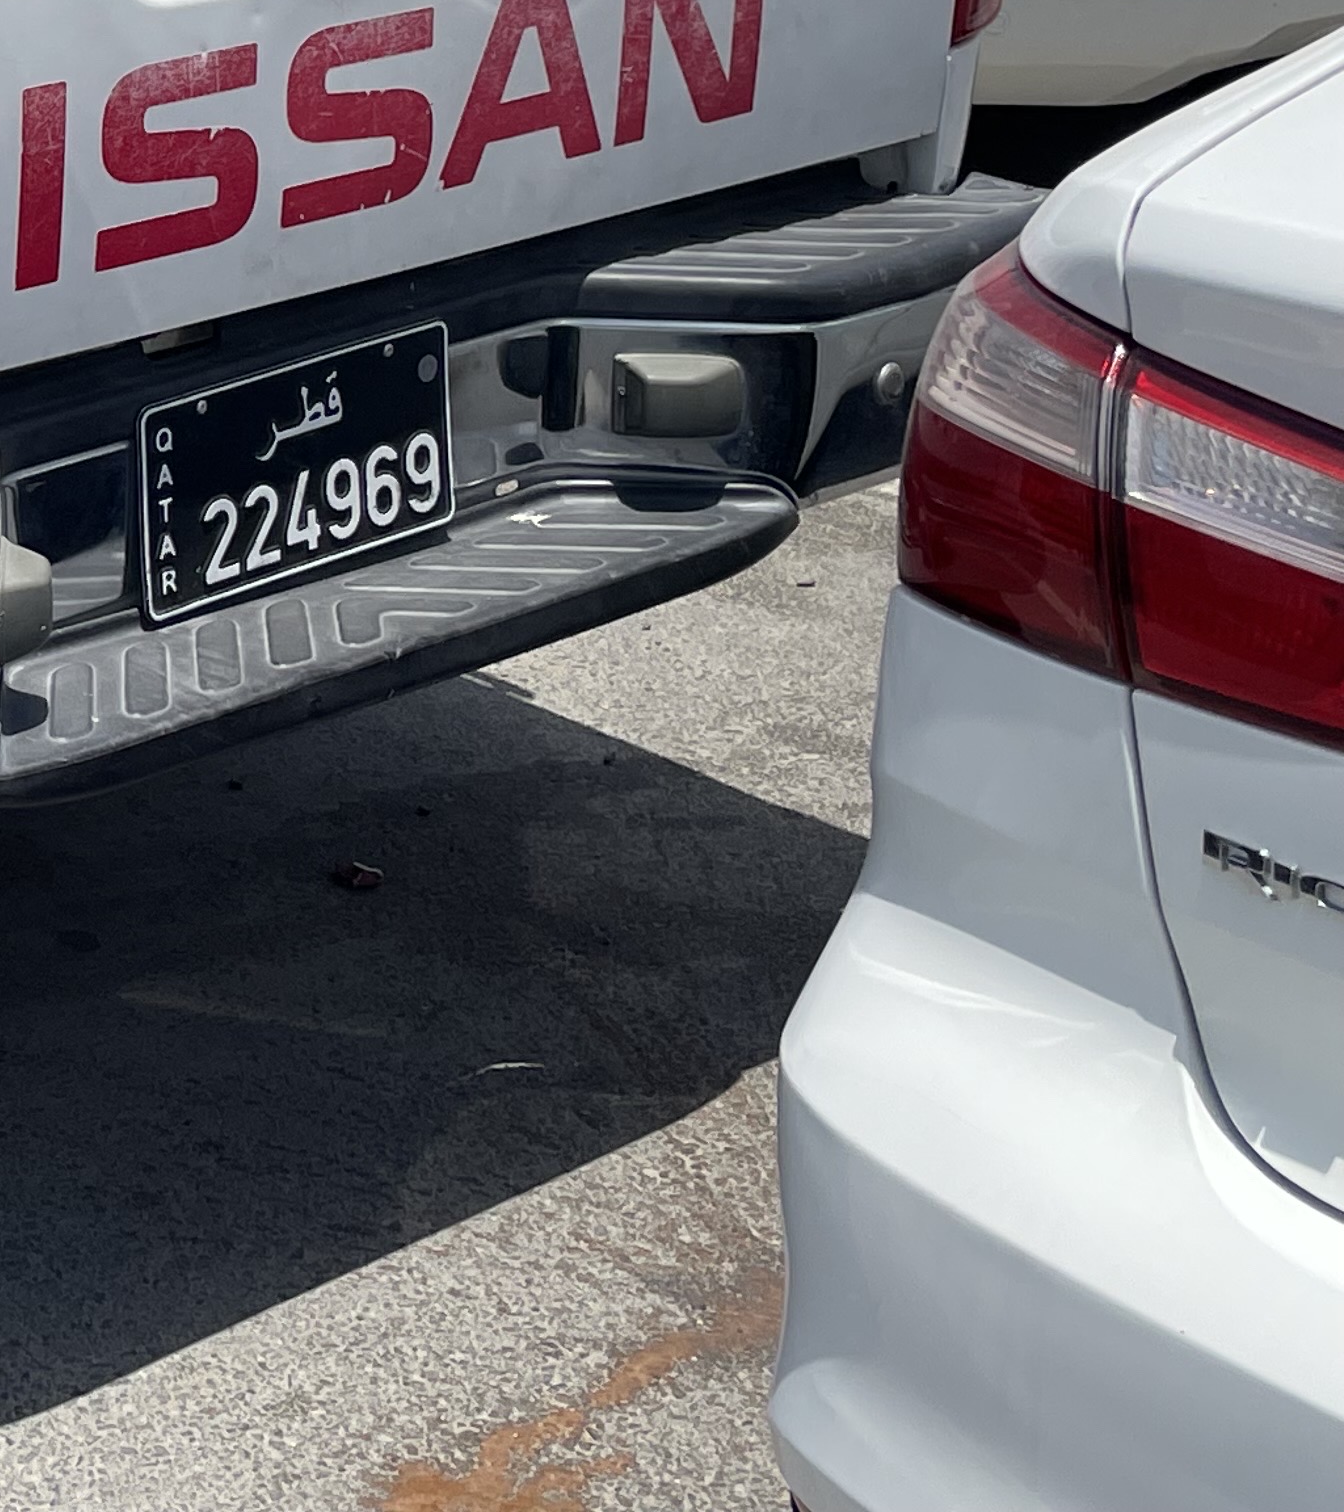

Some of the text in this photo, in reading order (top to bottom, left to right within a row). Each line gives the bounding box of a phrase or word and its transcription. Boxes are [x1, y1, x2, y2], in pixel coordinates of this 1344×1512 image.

[255, 370, 344, 462] قطر
[154, 427, 178, 596] QATAR
[203, 432, 441, 586] 224969
